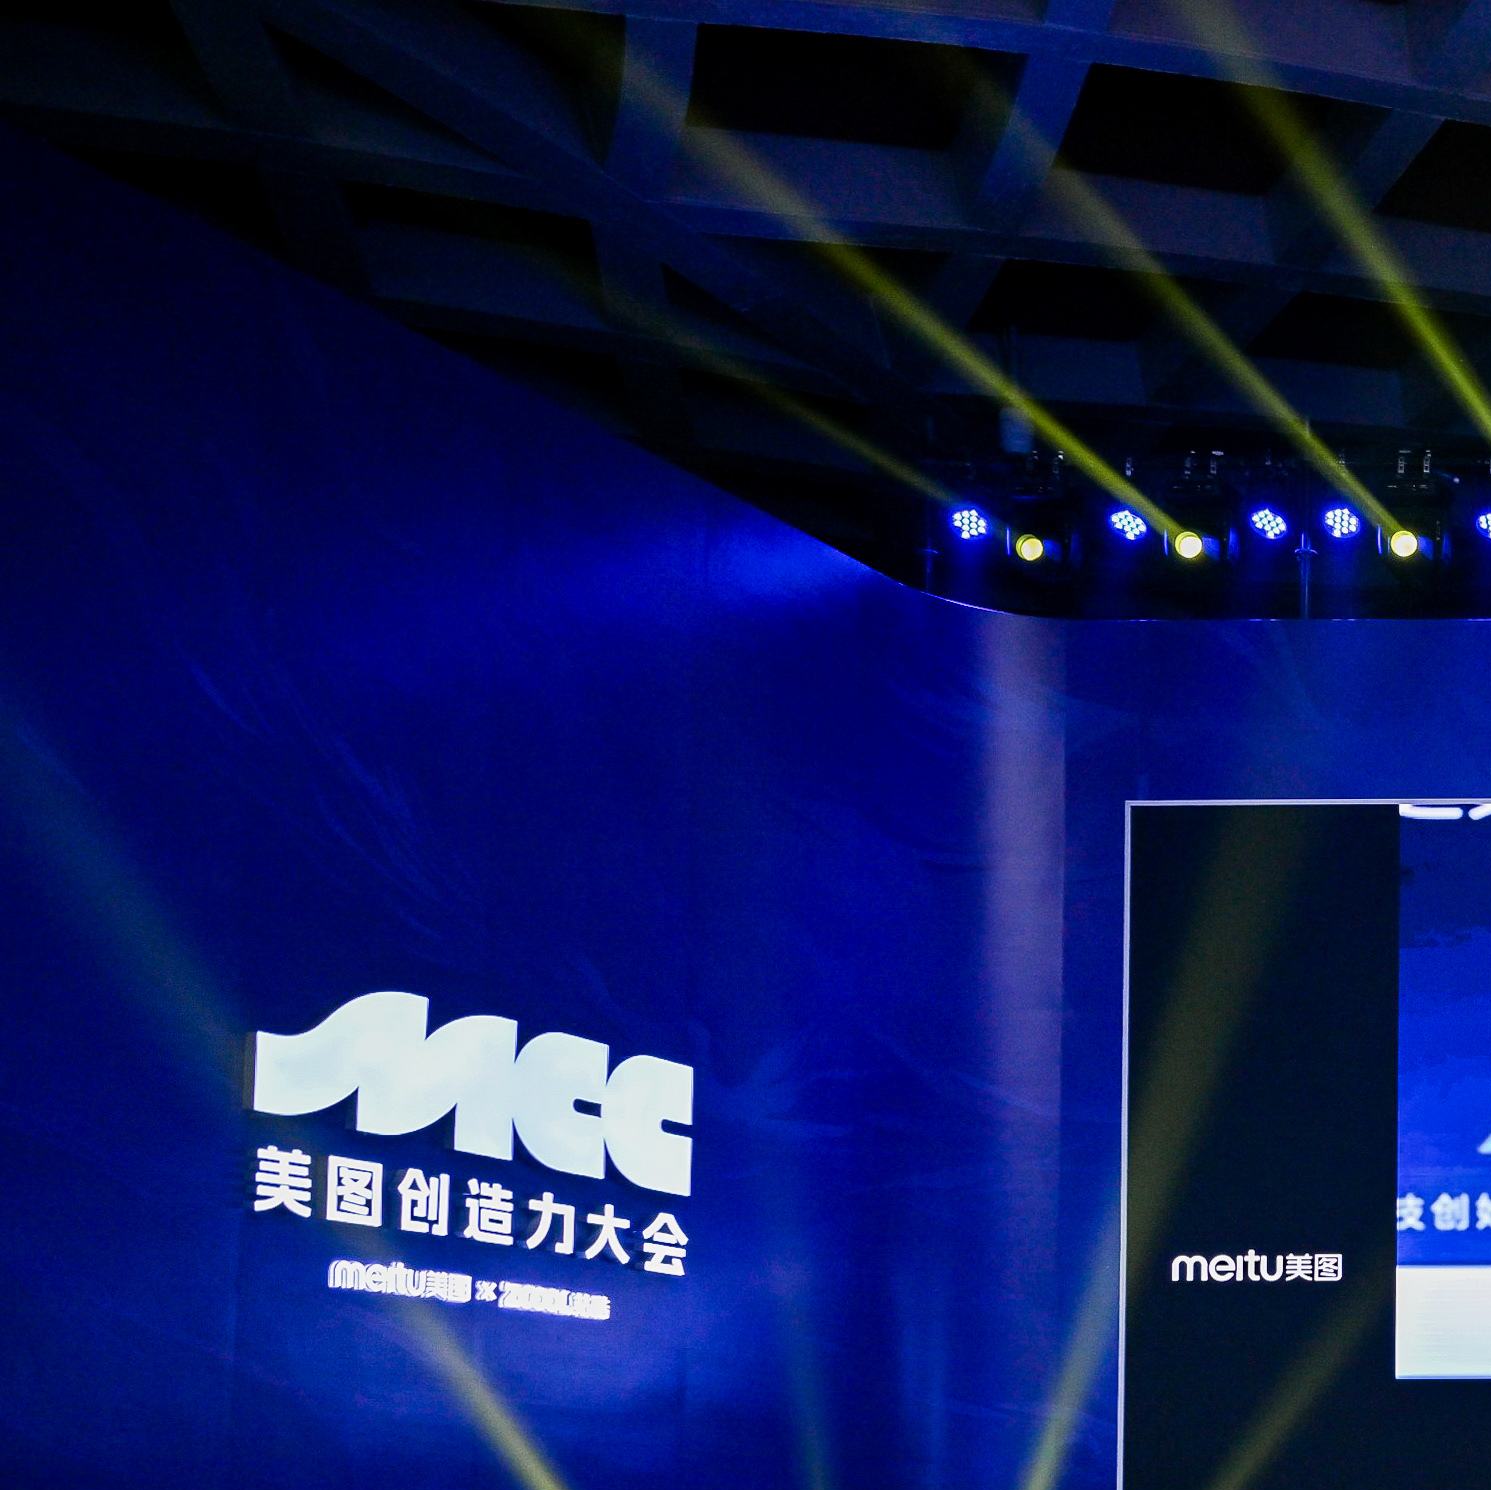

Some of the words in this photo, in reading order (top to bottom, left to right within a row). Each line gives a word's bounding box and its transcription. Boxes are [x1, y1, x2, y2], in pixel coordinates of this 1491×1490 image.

[253, 1145, 689, 1276] 美图创造力大会
